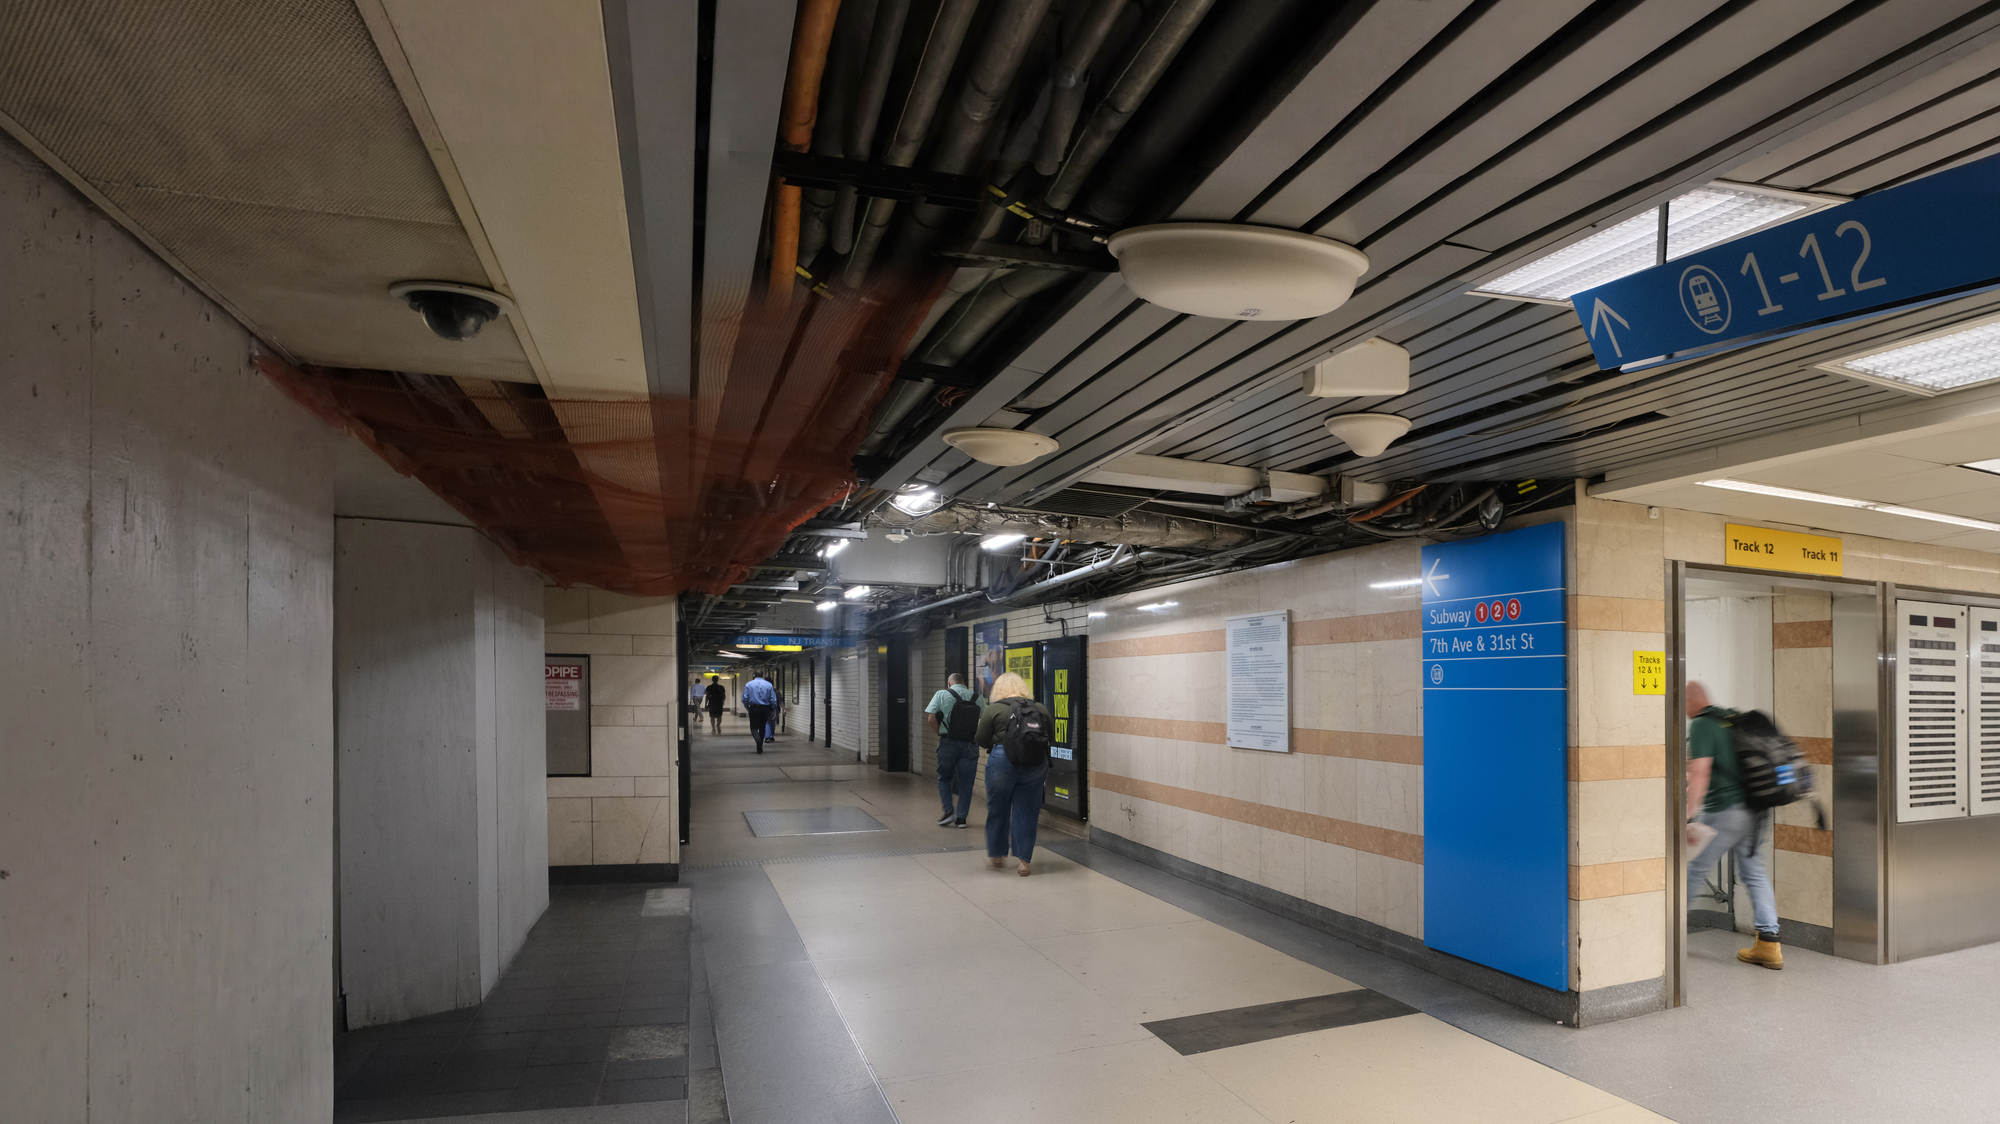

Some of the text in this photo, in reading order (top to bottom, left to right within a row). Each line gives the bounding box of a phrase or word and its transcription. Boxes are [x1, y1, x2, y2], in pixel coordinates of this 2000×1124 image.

[1740, 220, 1886, 316] 1-12
[1733, 539, 1774, 554] Track 12
[1802, 547, 1838, 562] Track 11
[1430, 609, 1471, 627] Subway
[749, 636, 769, 644] LIRR
[788, 637, 840, 646] NJ TRANSIT
[1430, 632, 1534, 653] 7th Ave & 31st St
[1639, 655, 1660, 664] Tracks
[1054, 669, 1068, 693] NEW
[1054, 694, 1069, 718] YORK
[1054, 719, 1068, 744] CITY
